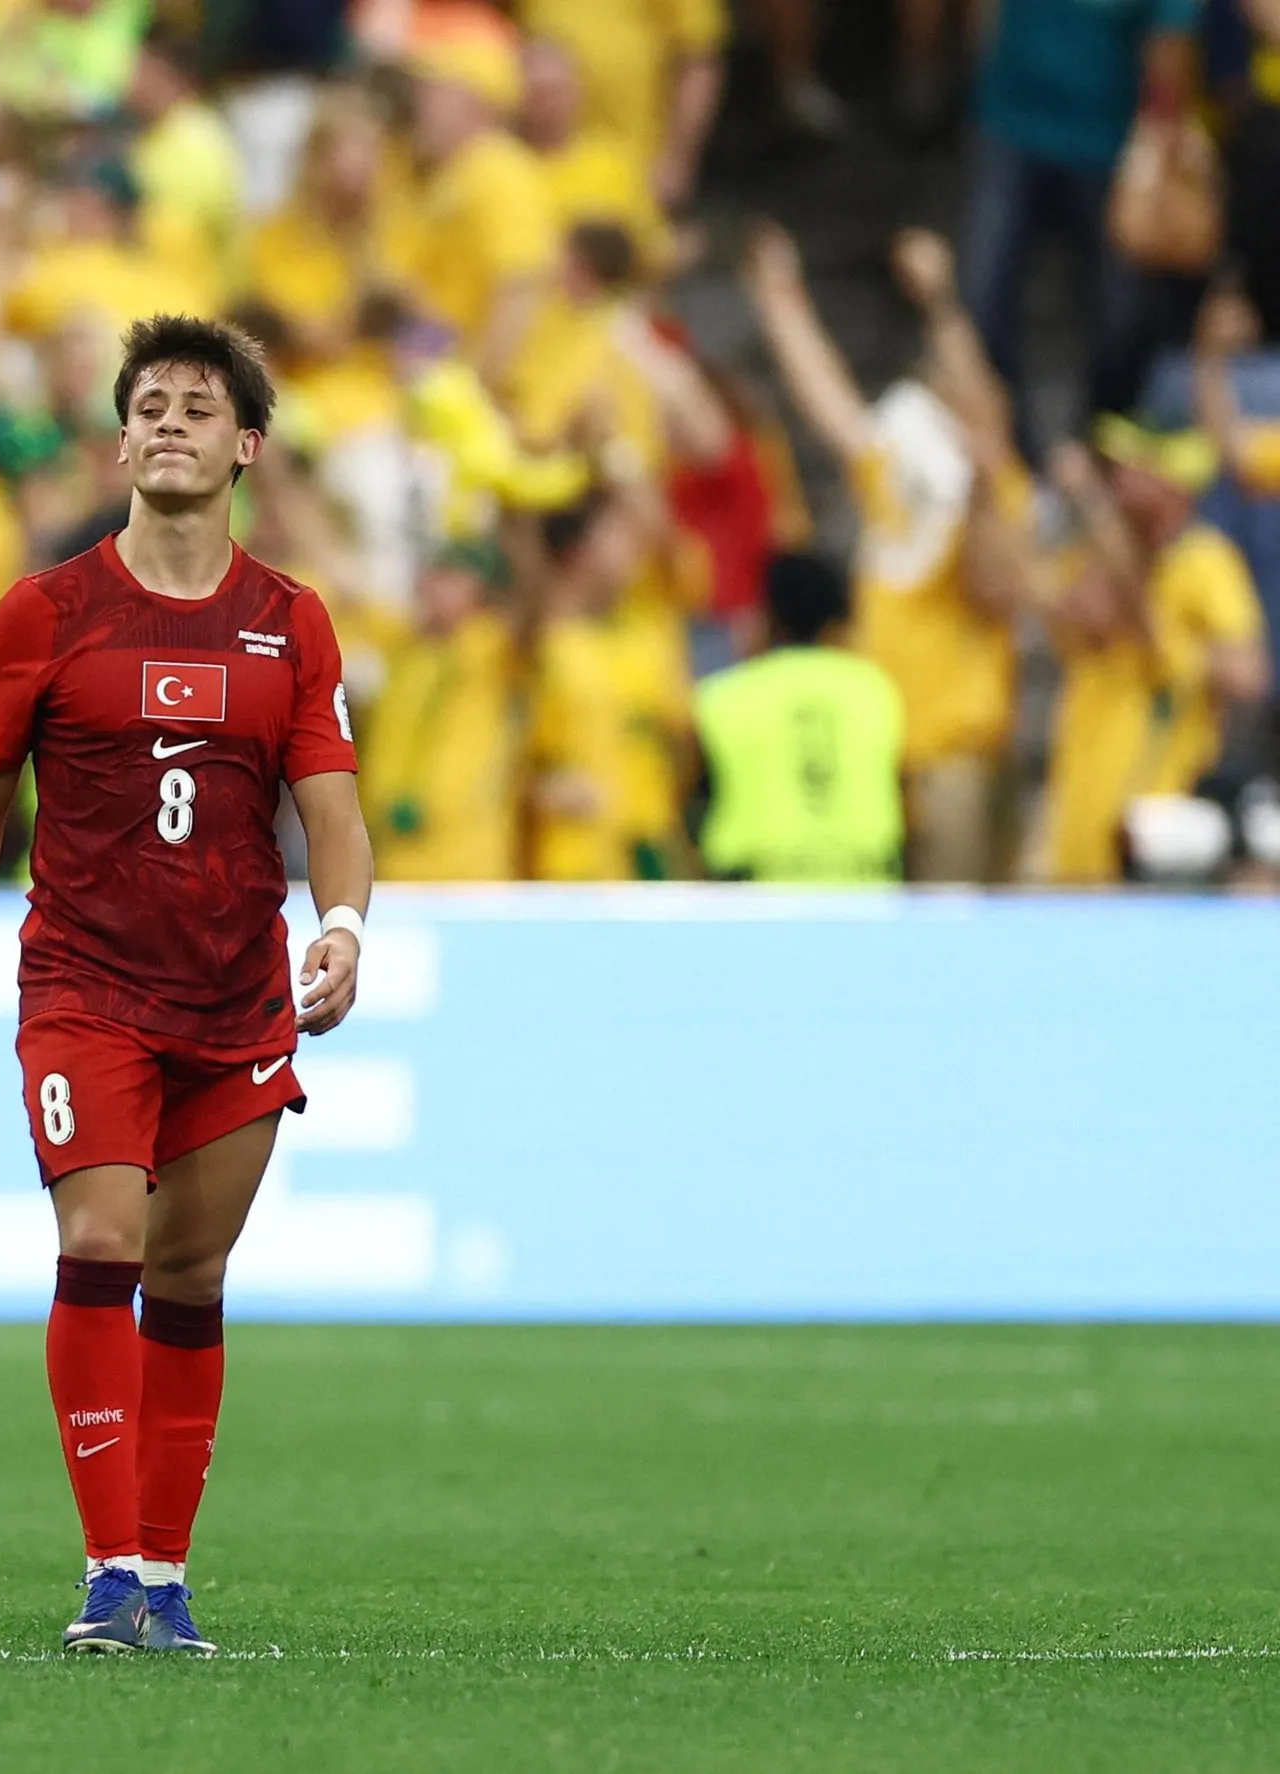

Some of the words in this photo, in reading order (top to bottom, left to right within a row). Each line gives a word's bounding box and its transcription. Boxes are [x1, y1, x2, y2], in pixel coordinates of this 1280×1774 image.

[157, 768, 196, 844] 8
[40, 1072, 75, 1146] 8
[69, 1407, 125, 1427] TÜRKİYE
